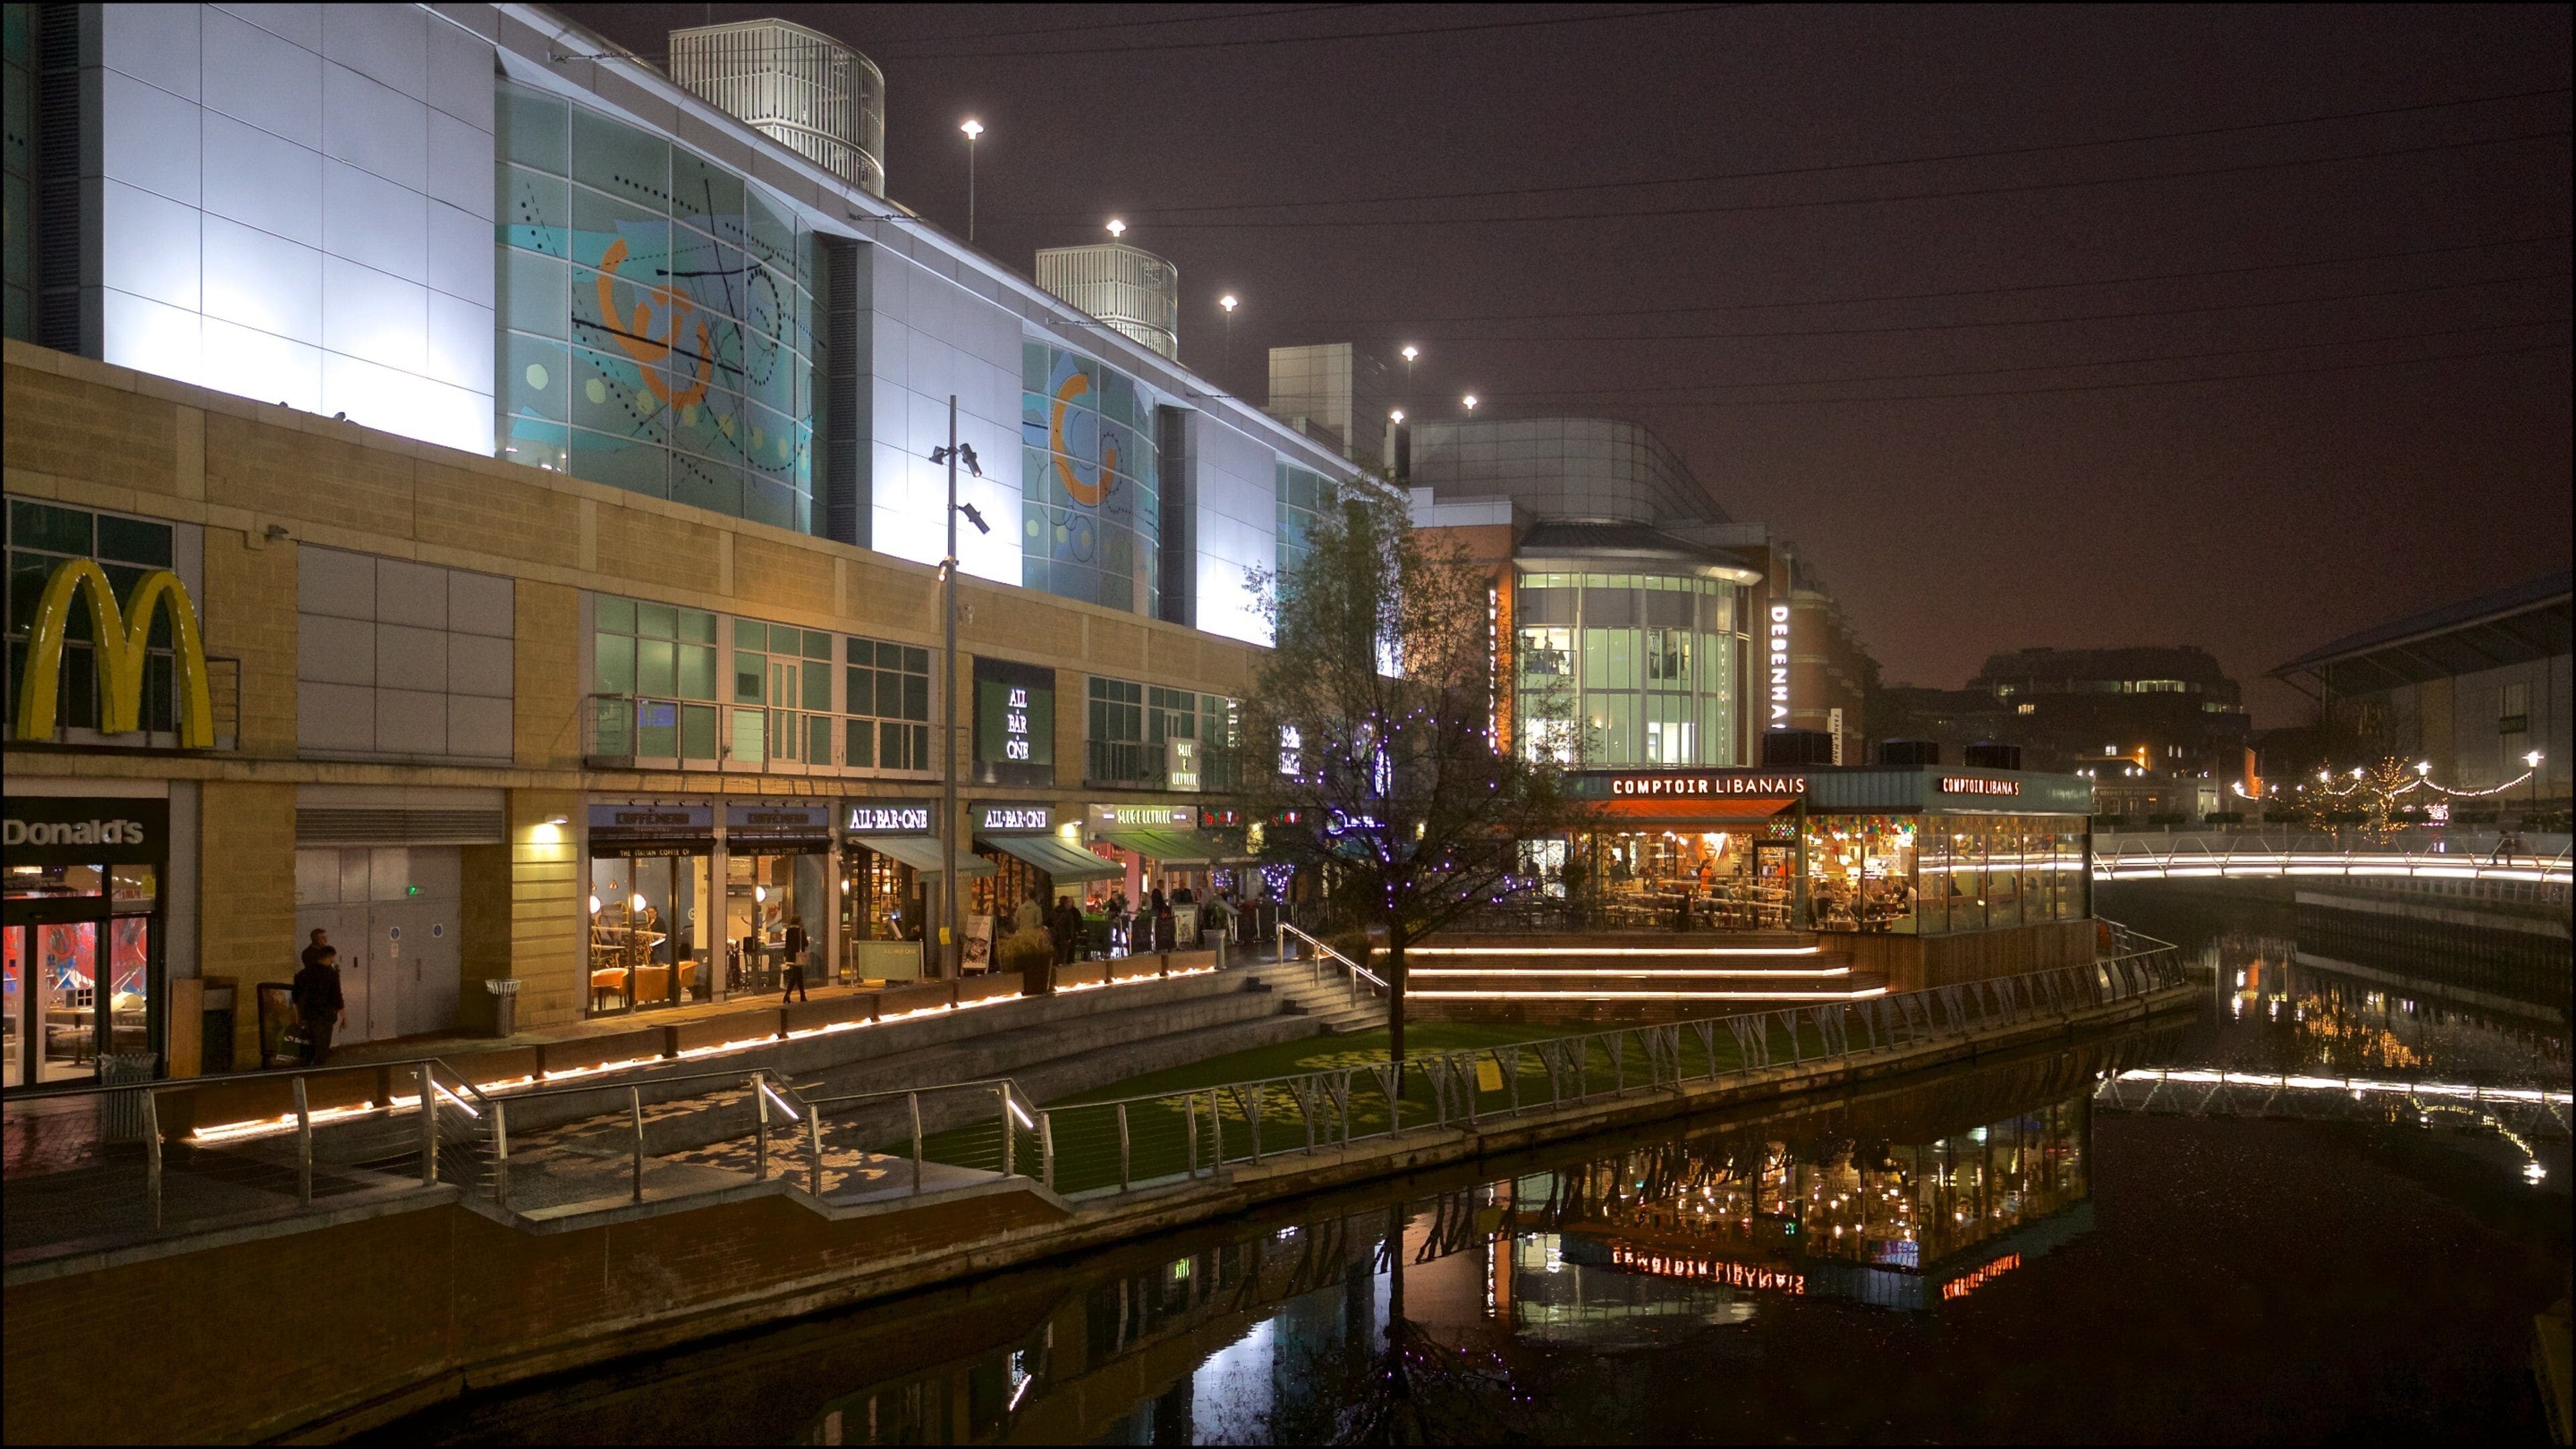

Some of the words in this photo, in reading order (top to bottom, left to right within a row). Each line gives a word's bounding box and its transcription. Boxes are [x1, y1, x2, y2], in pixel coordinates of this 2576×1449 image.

[1009, 689, 1027, 708] ALL
[1008, 714, 1027, 734] BAR
[1007, 741, 1028, 759] ONE
[1613, 780, 1708, 794] COMPTOIR
[1716, 779, 1805, 793] LIBANAIS
[1943, 778, 1984, 792] COMPTOIR
[3, 819, 144, 845] Donald's
